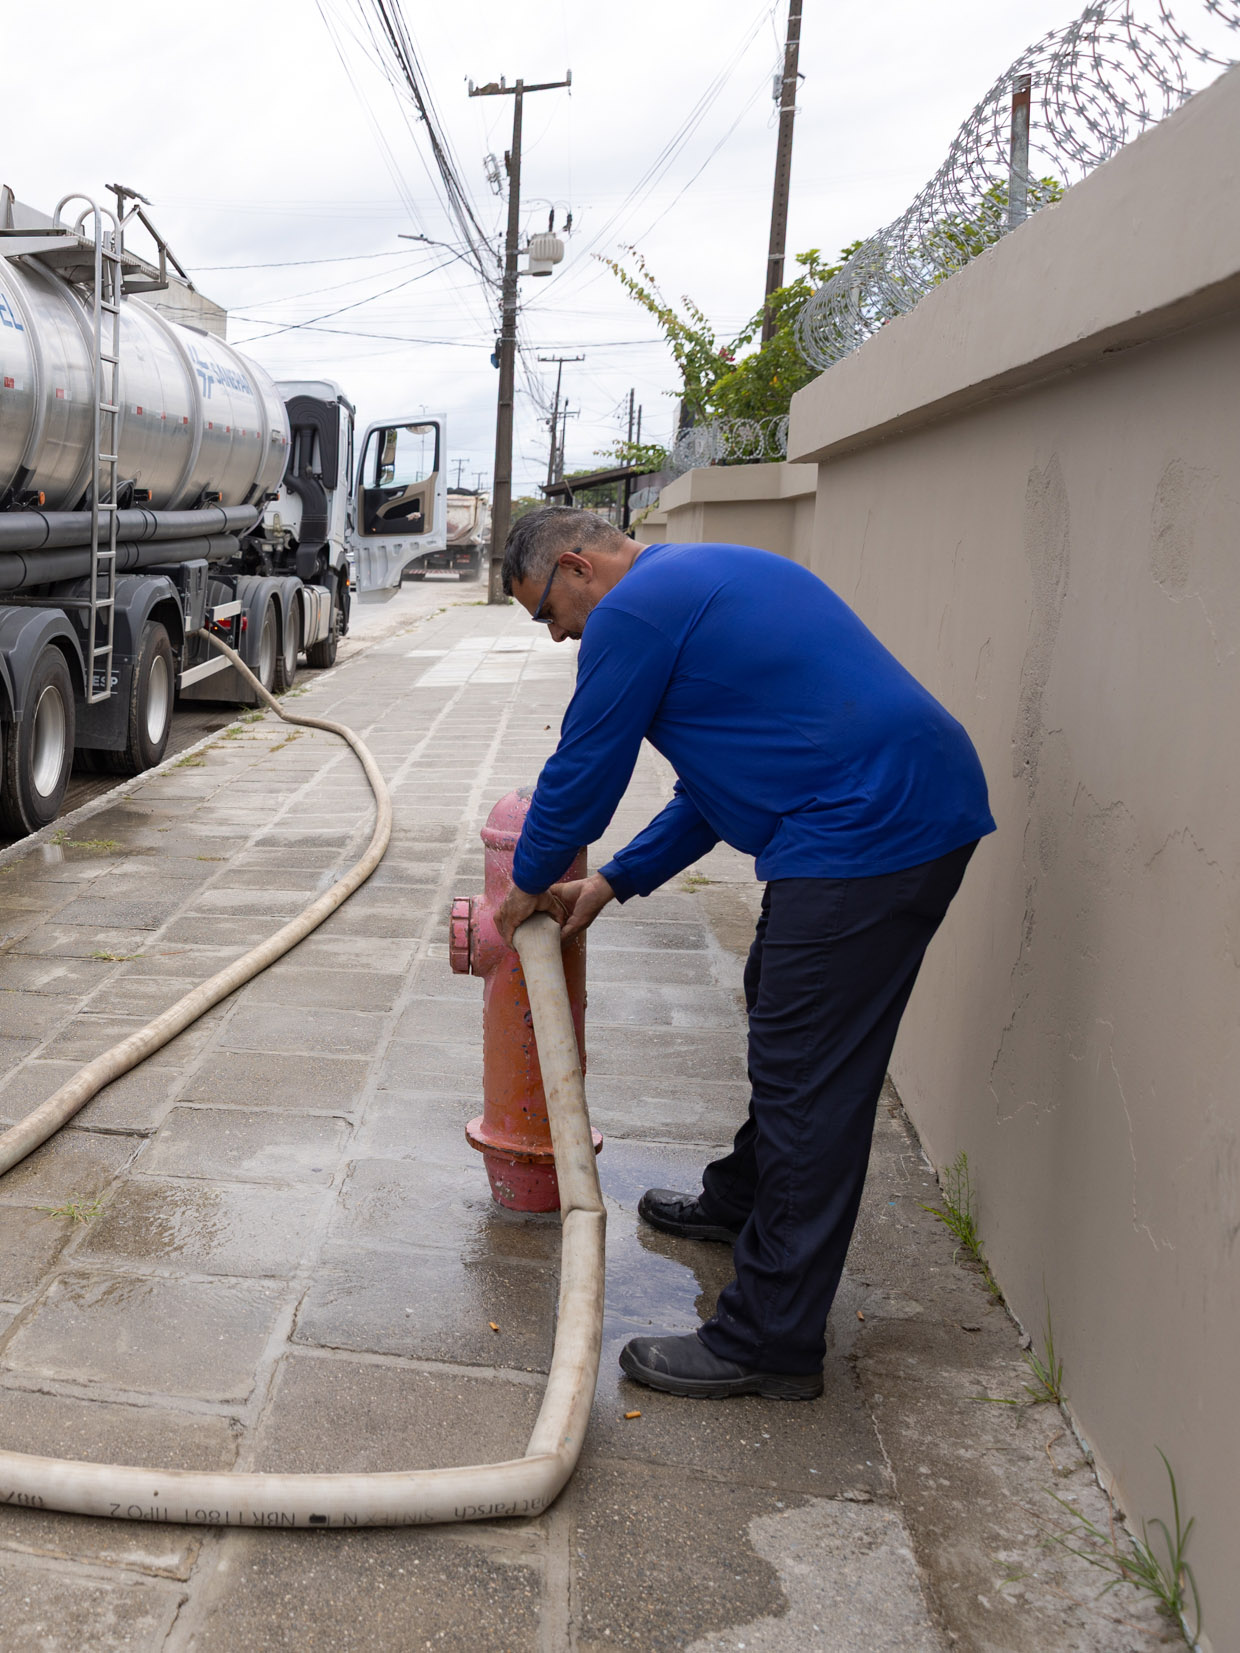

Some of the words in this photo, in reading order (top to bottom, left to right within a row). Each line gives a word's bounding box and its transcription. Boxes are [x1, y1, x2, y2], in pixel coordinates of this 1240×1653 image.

[109, 1503, 121, 1517] 2
[454, 1500, 518, 1520] Parsch
[252, 1512, 296, 1526] NBR
